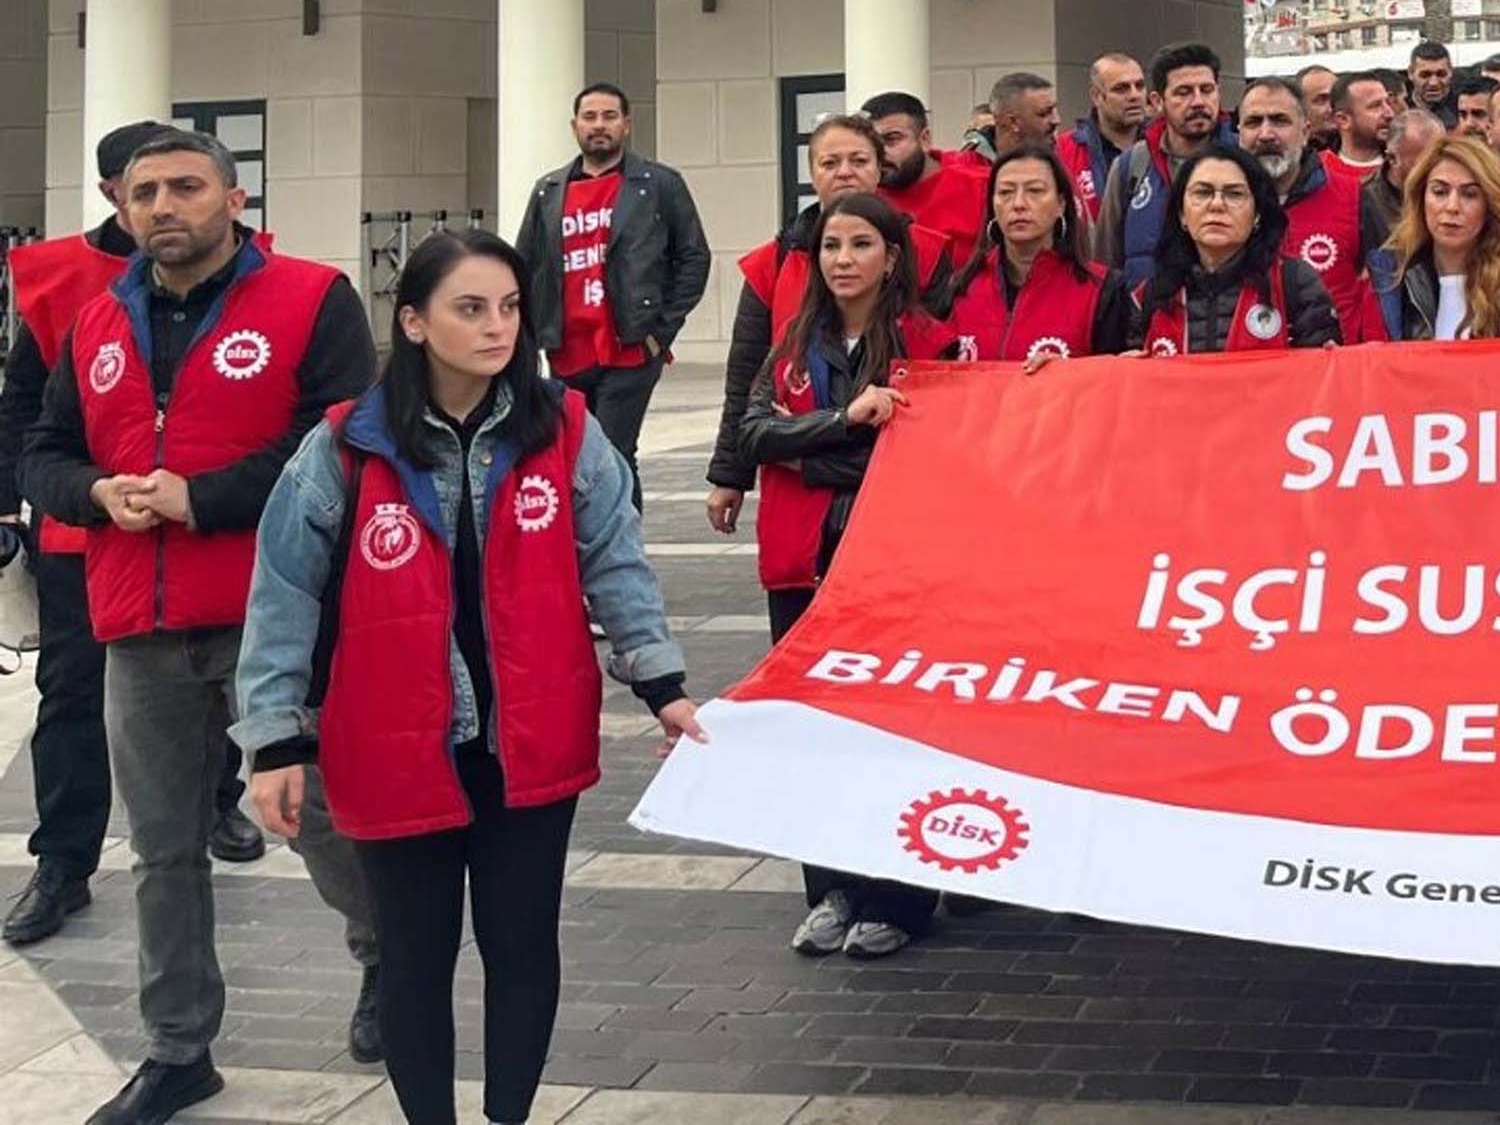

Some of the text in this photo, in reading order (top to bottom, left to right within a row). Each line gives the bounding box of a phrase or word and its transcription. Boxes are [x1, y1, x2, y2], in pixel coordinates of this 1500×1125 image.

[562, 208, 614, 237] DİSK
[563, 242, 608, 272] ENE
[1137, 551, 1326, 651] İŞÇİ
[807, 649, 1240, 733] BİRİKEN
[927, 814, 1001, 847] DİSK
[1264, 858, 1375, 895] DİSK
